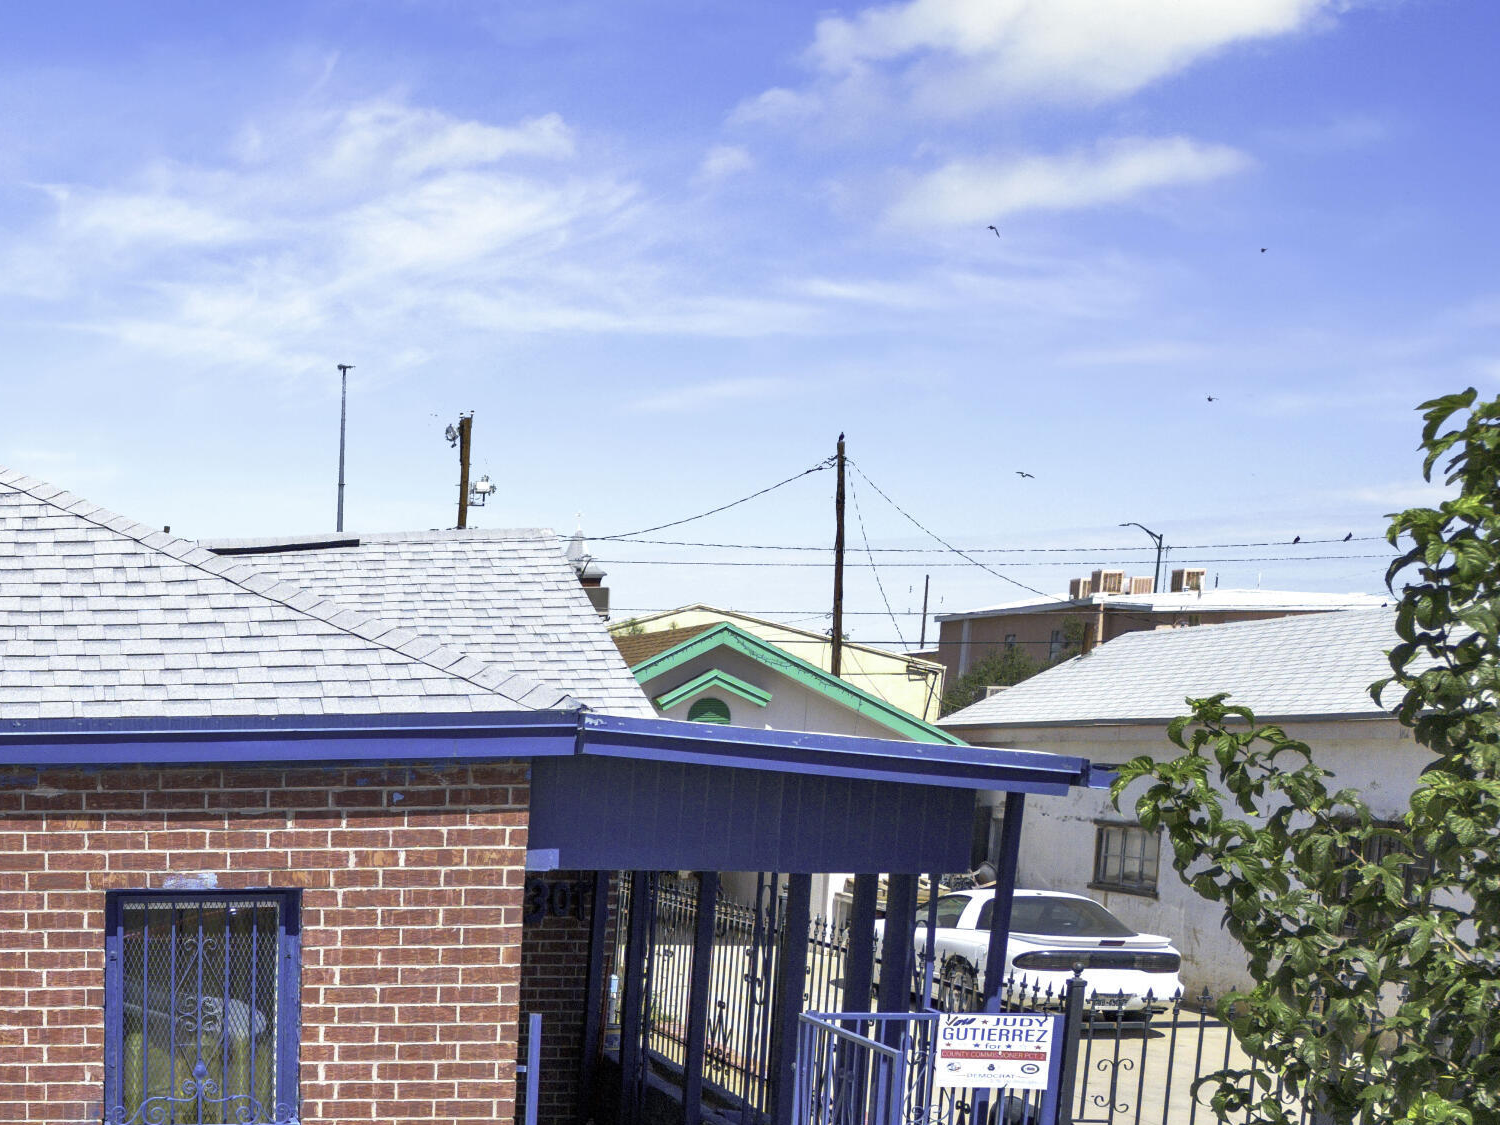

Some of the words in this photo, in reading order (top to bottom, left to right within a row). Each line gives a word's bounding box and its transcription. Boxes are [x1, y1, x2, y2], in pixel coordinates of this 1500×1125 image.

[992, 1018, 1048, 1027] JUDY
[942, 1027, 1048, 1043] GUTIERREZ
[970, 1051, 1023, 1060] COMMISSIONER
